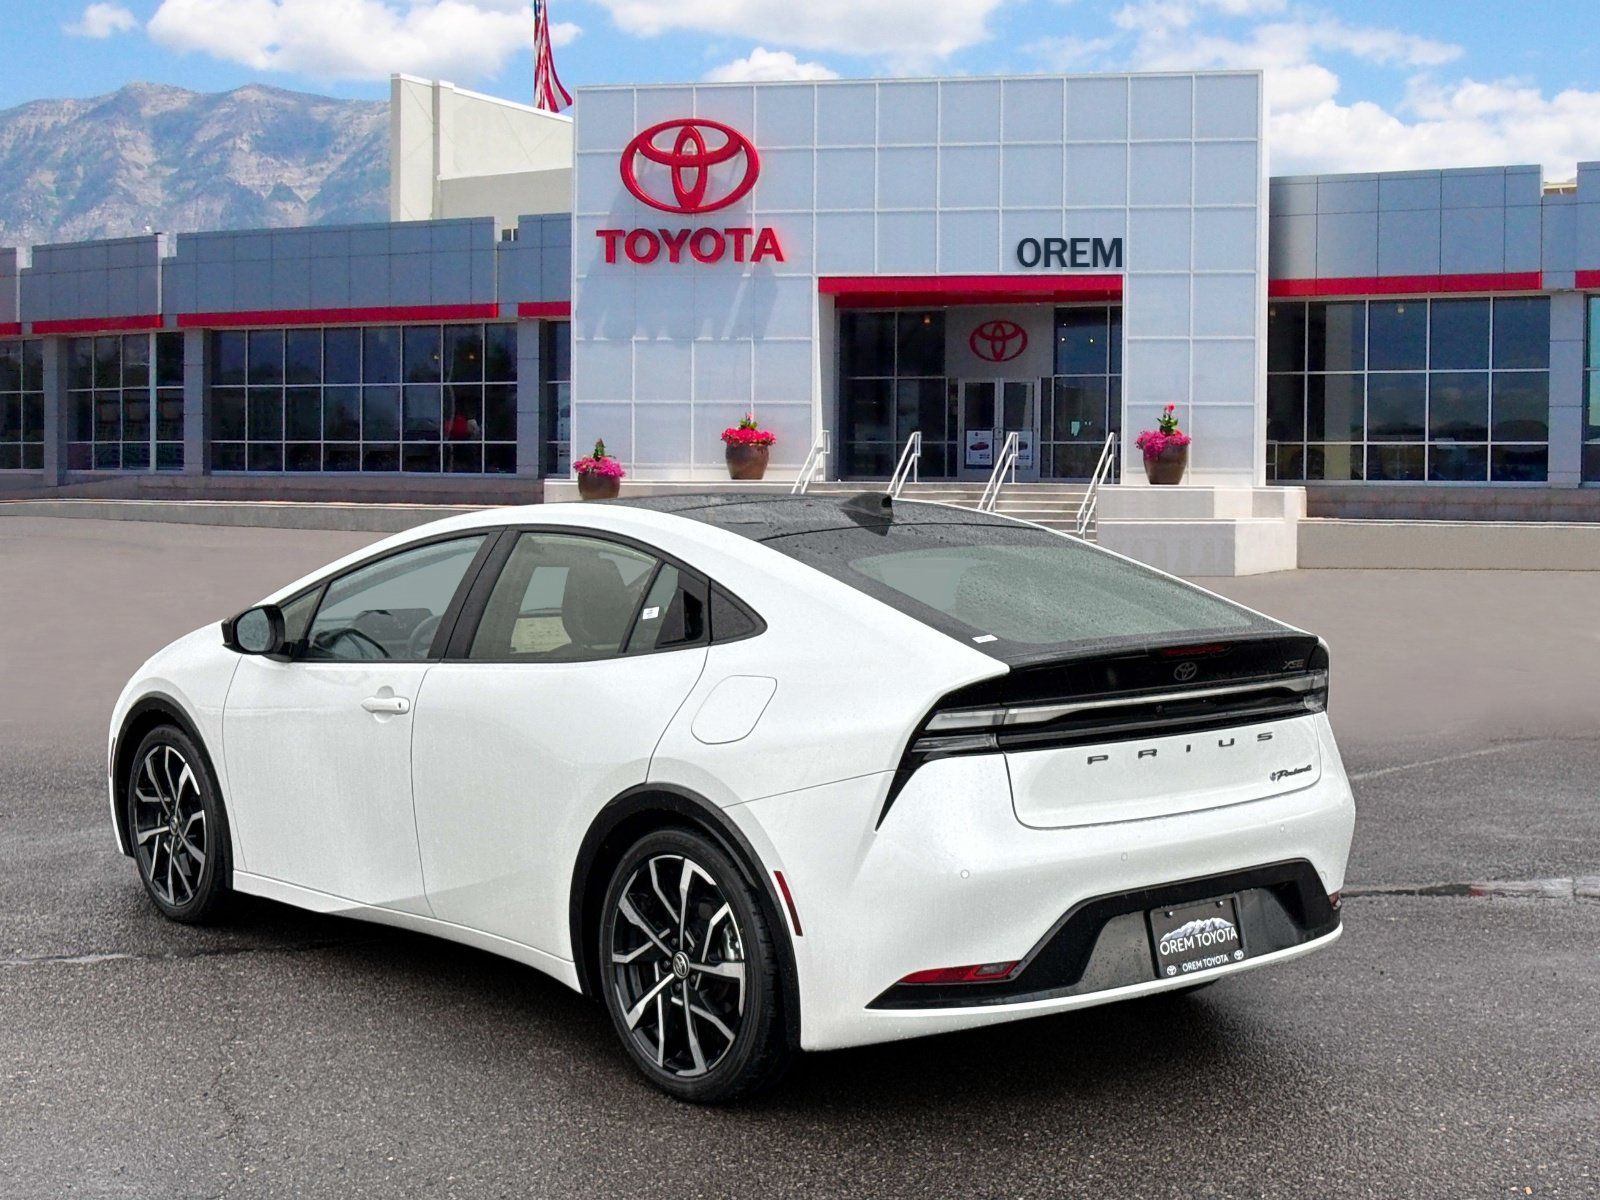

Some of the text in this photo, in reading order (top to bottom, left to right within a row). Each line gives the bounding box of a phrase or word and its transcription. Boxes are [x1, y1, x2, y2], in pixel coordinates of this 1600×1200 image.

[596, 227, 785, 264] TOYOTA
[1017, 237, 1123, 268] OREM
[1087, 731, 1273, 765] PRIUS
[1160, 926, 1238, 956] OREM TOYOTA
[1182, 954, 1229, 972] OREM TOYOTA
